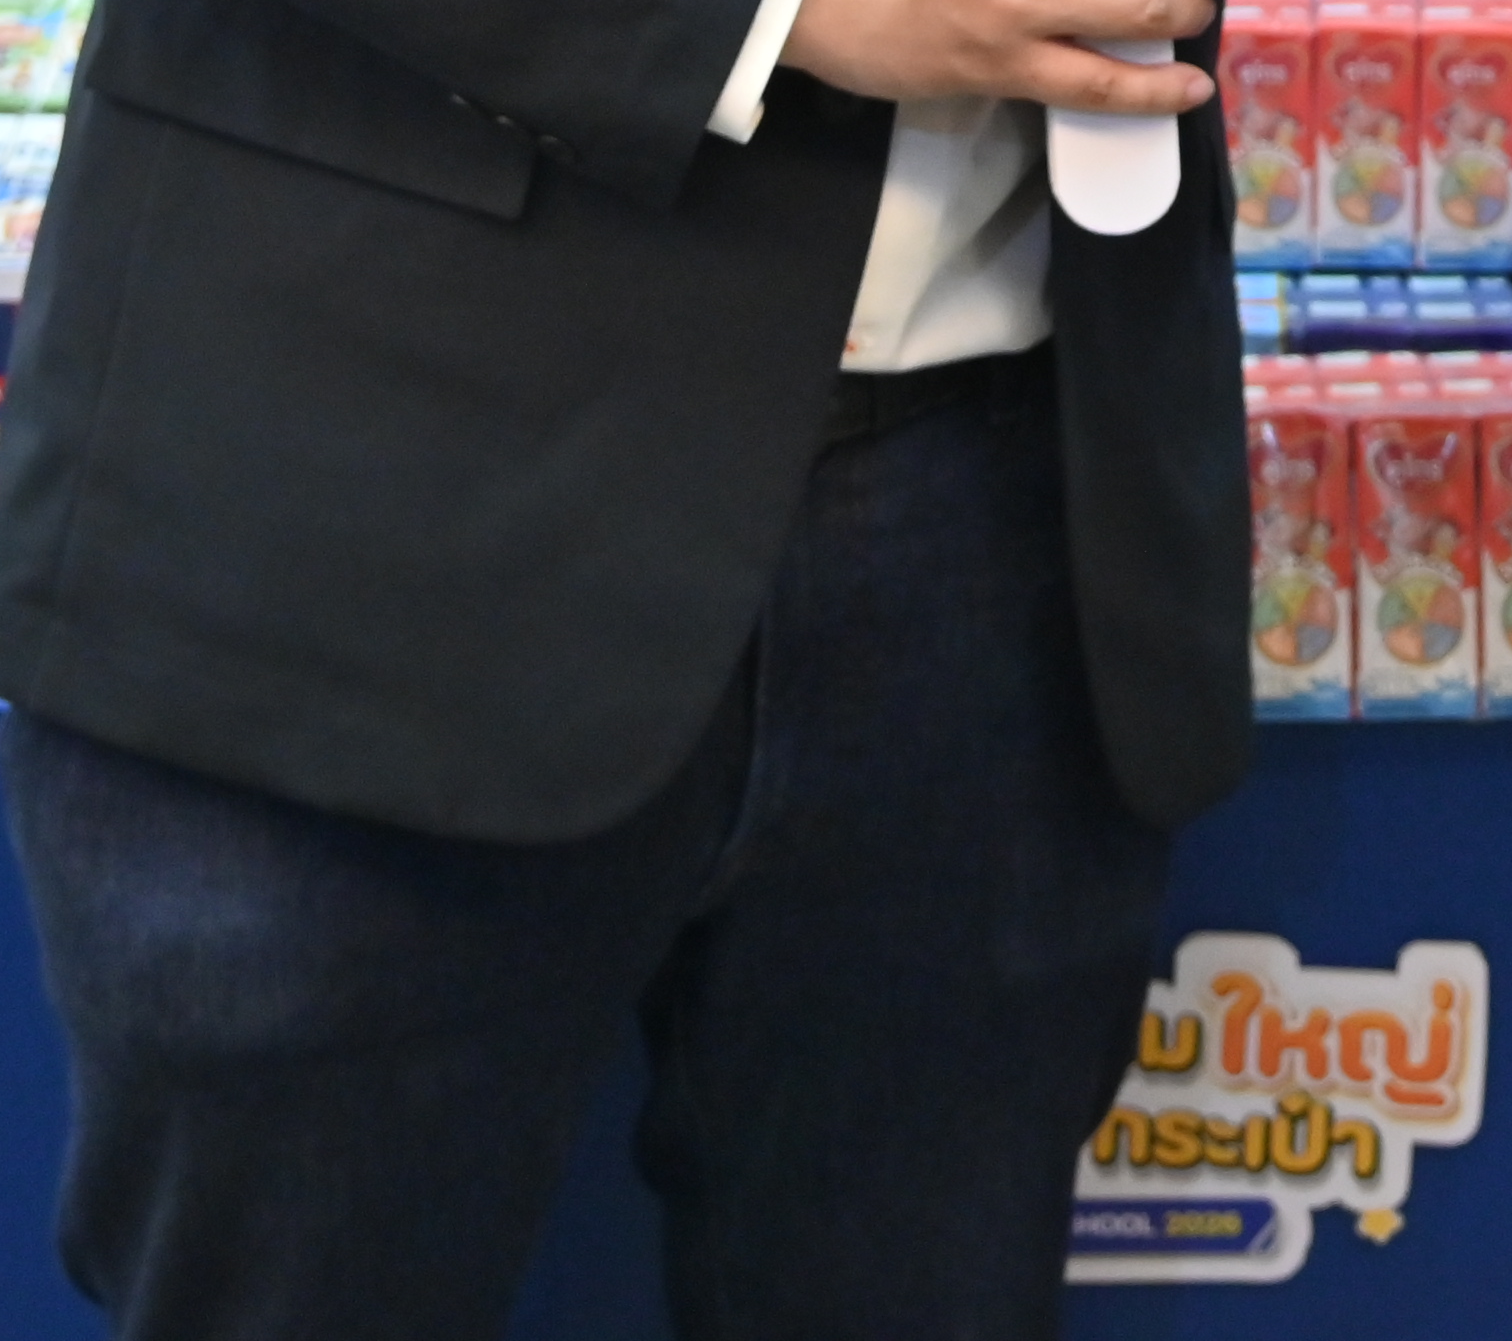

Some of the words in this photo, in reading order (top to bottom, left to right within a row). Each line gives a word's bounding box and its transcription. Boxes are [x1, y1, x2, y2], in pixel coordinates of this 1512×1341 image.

[1211, 972, 1455, 1107] ใหญ่
[1091, 1090, 1380, 1179] กระเป๋า
